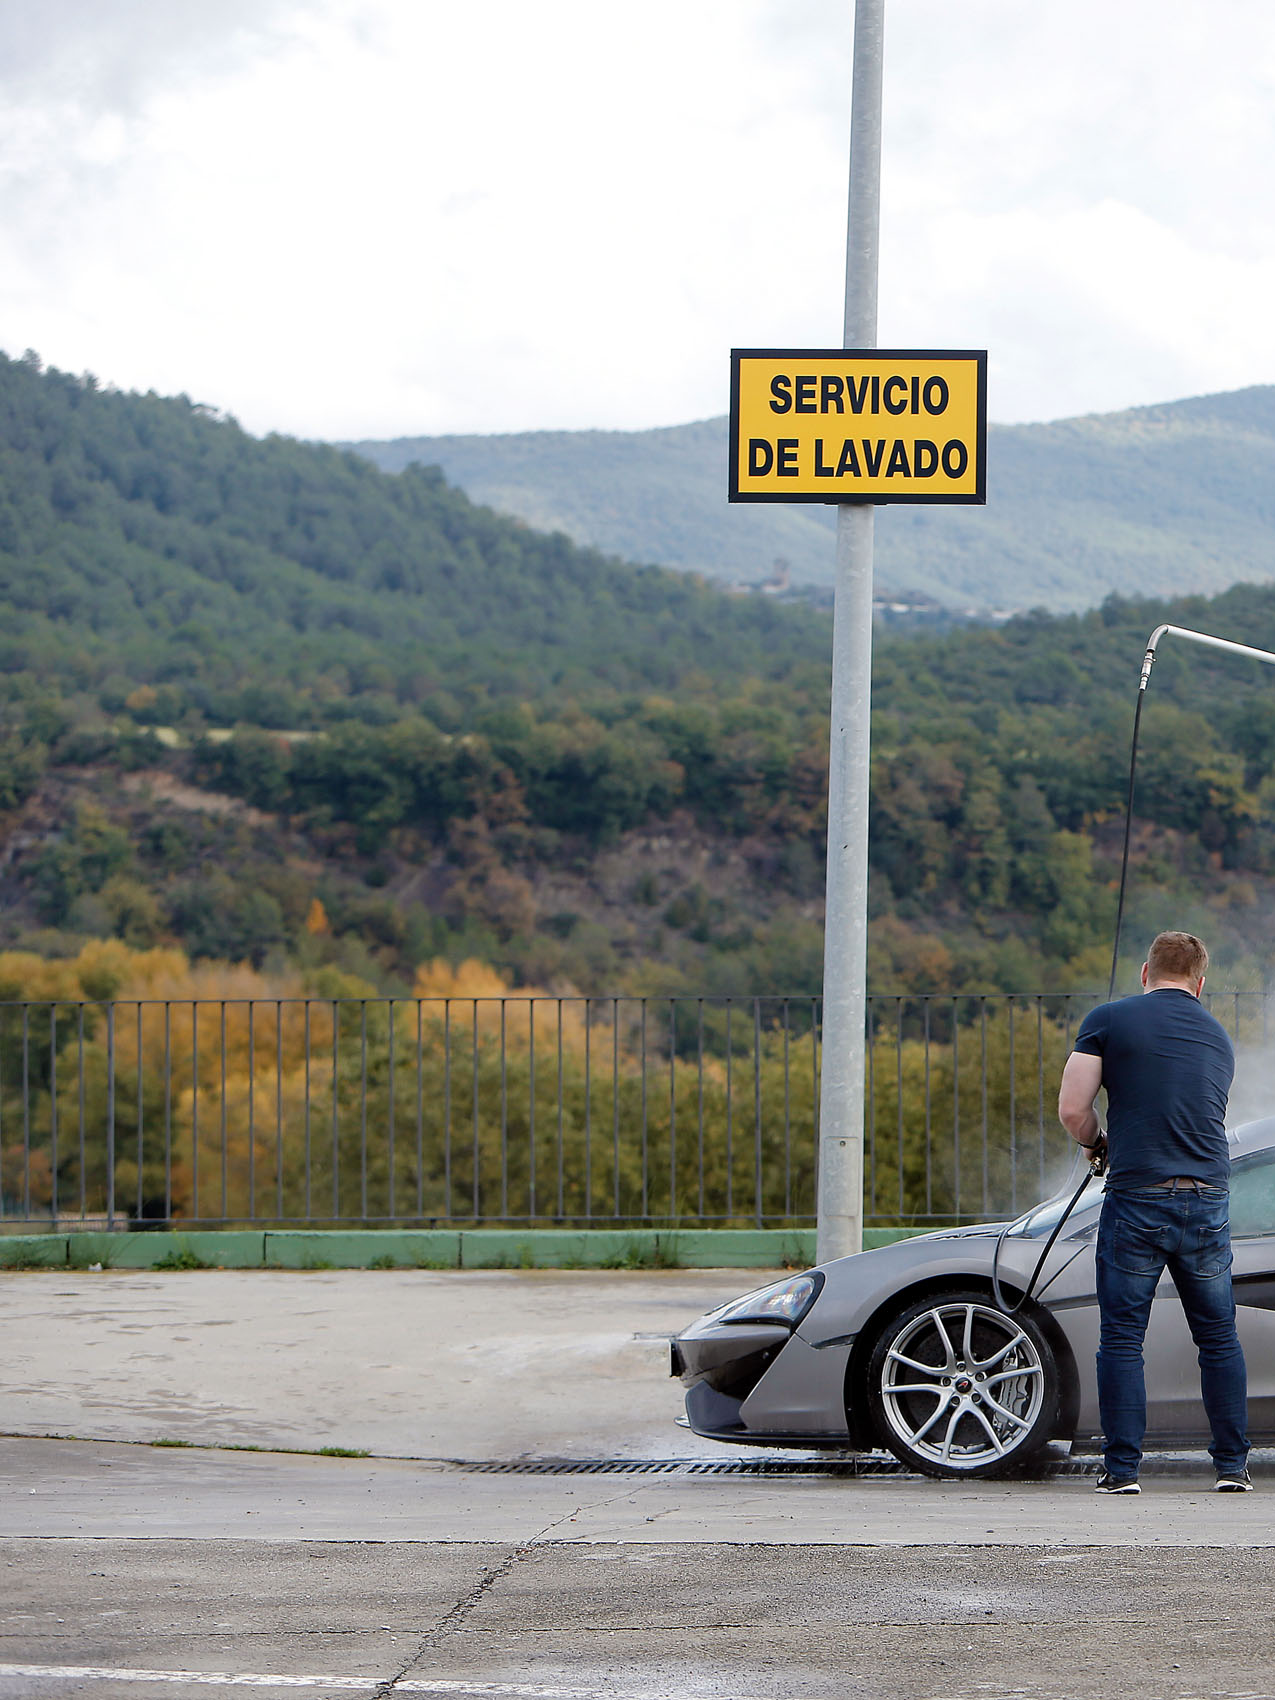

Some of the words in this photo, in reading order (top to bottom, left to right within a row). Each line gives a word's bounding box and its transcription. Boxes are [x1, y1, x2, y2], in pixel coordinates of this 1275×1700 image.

[769, 374, 950, 416] SERVICIO
[748, 438, 800, 477] DE
[814, 438, 969, 479] LAVADO
